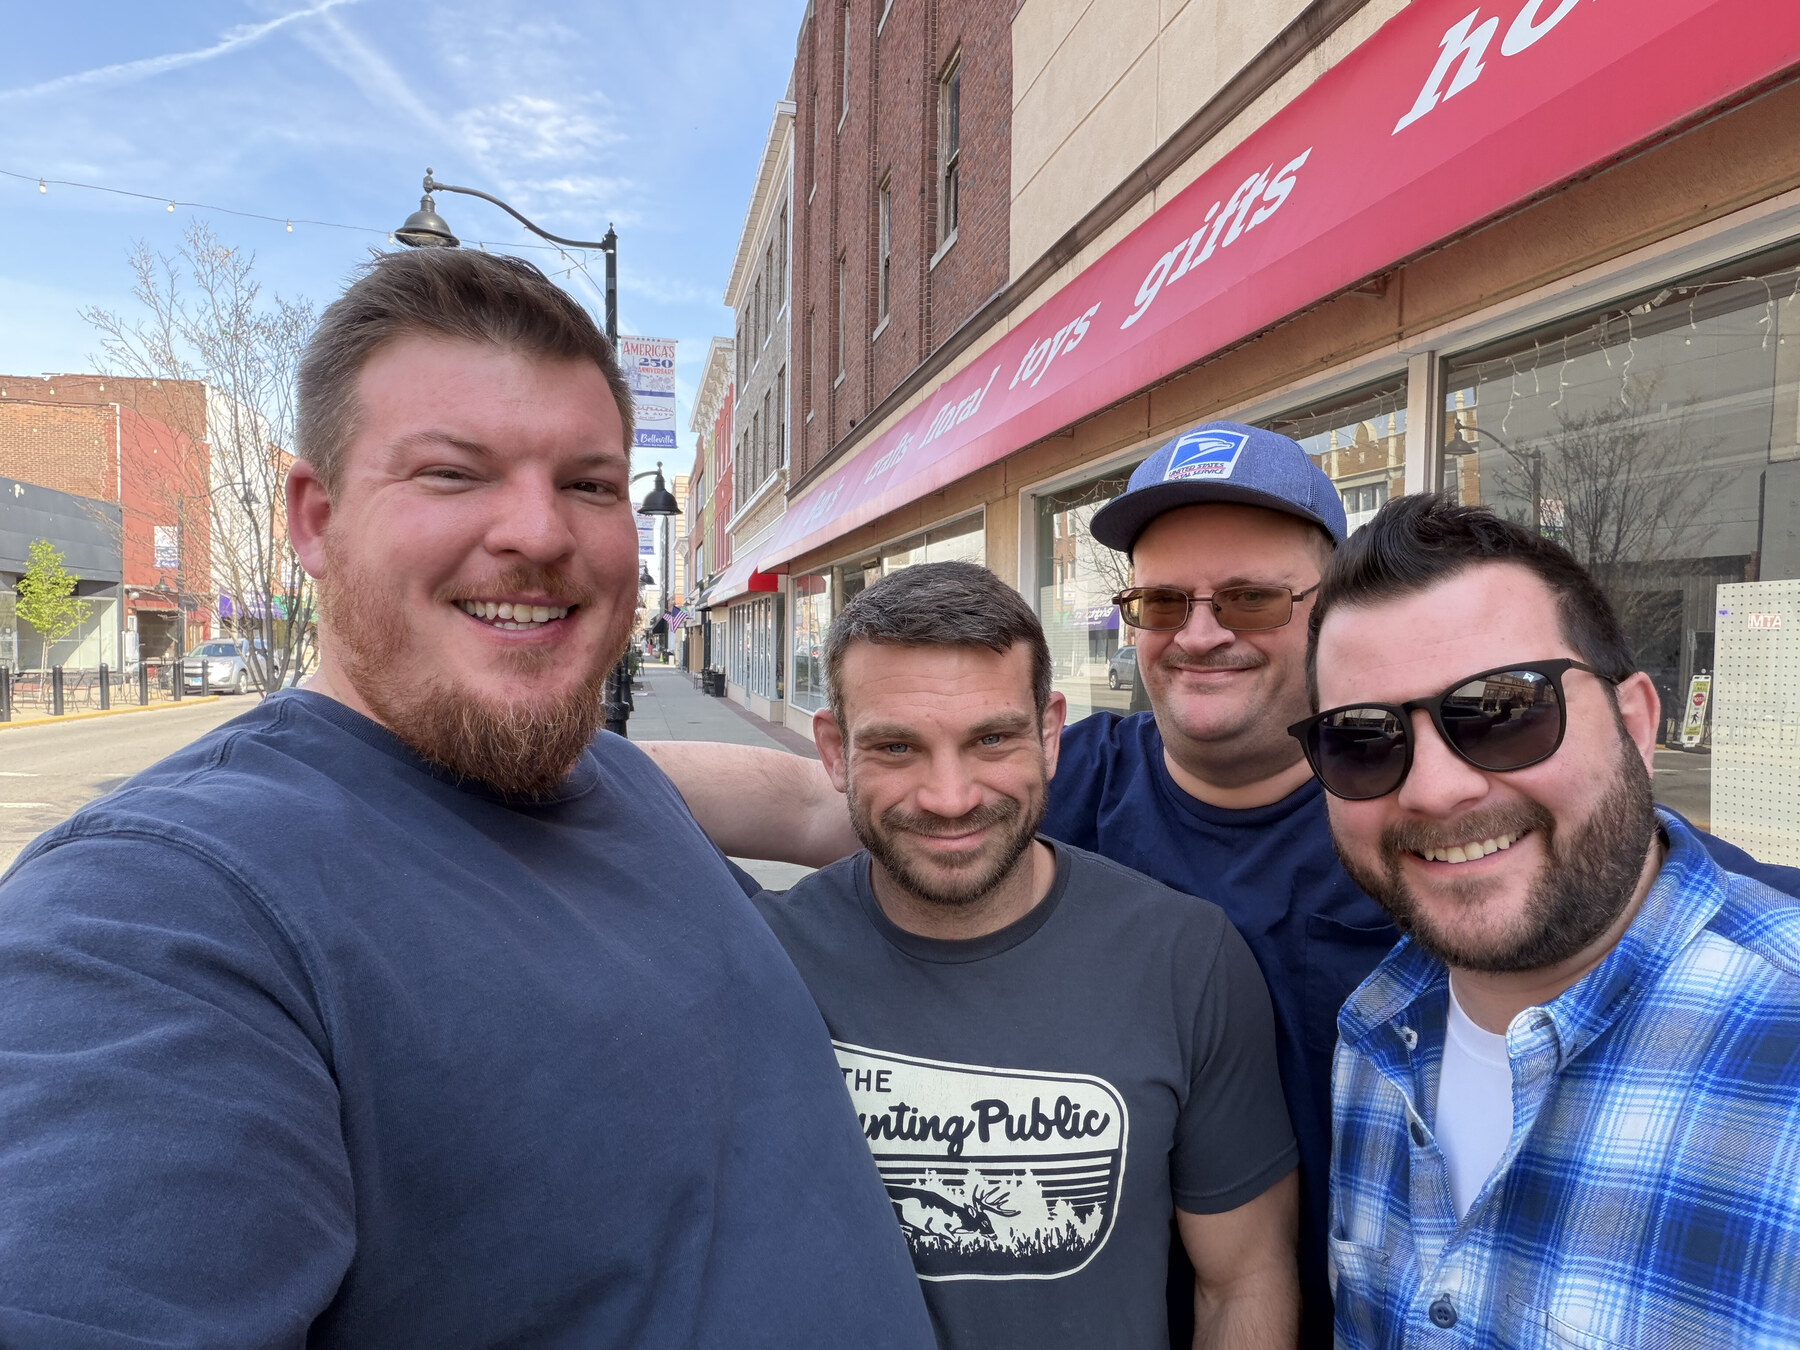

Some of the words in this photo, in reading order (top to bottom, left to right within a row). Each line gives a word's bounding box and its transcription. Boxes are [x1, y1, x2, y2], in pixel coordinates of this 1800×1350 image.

[917, 364, 1002, 450] floral
[1008, 301, 1102, 391] toys
[1119, 146, 1313, 330] gifts
[1391, 0, 1580, 136] ho
[623, 341, 674, 358] AMERICA'S
[639, 357, 673, 368] 250
[640, 433, 673, 443] Belleville
[1169, 465, 1195, 476] UNITED
[1750, 614, 1781, 628] MTA
[970, 1094, 1111, 1143] Public
